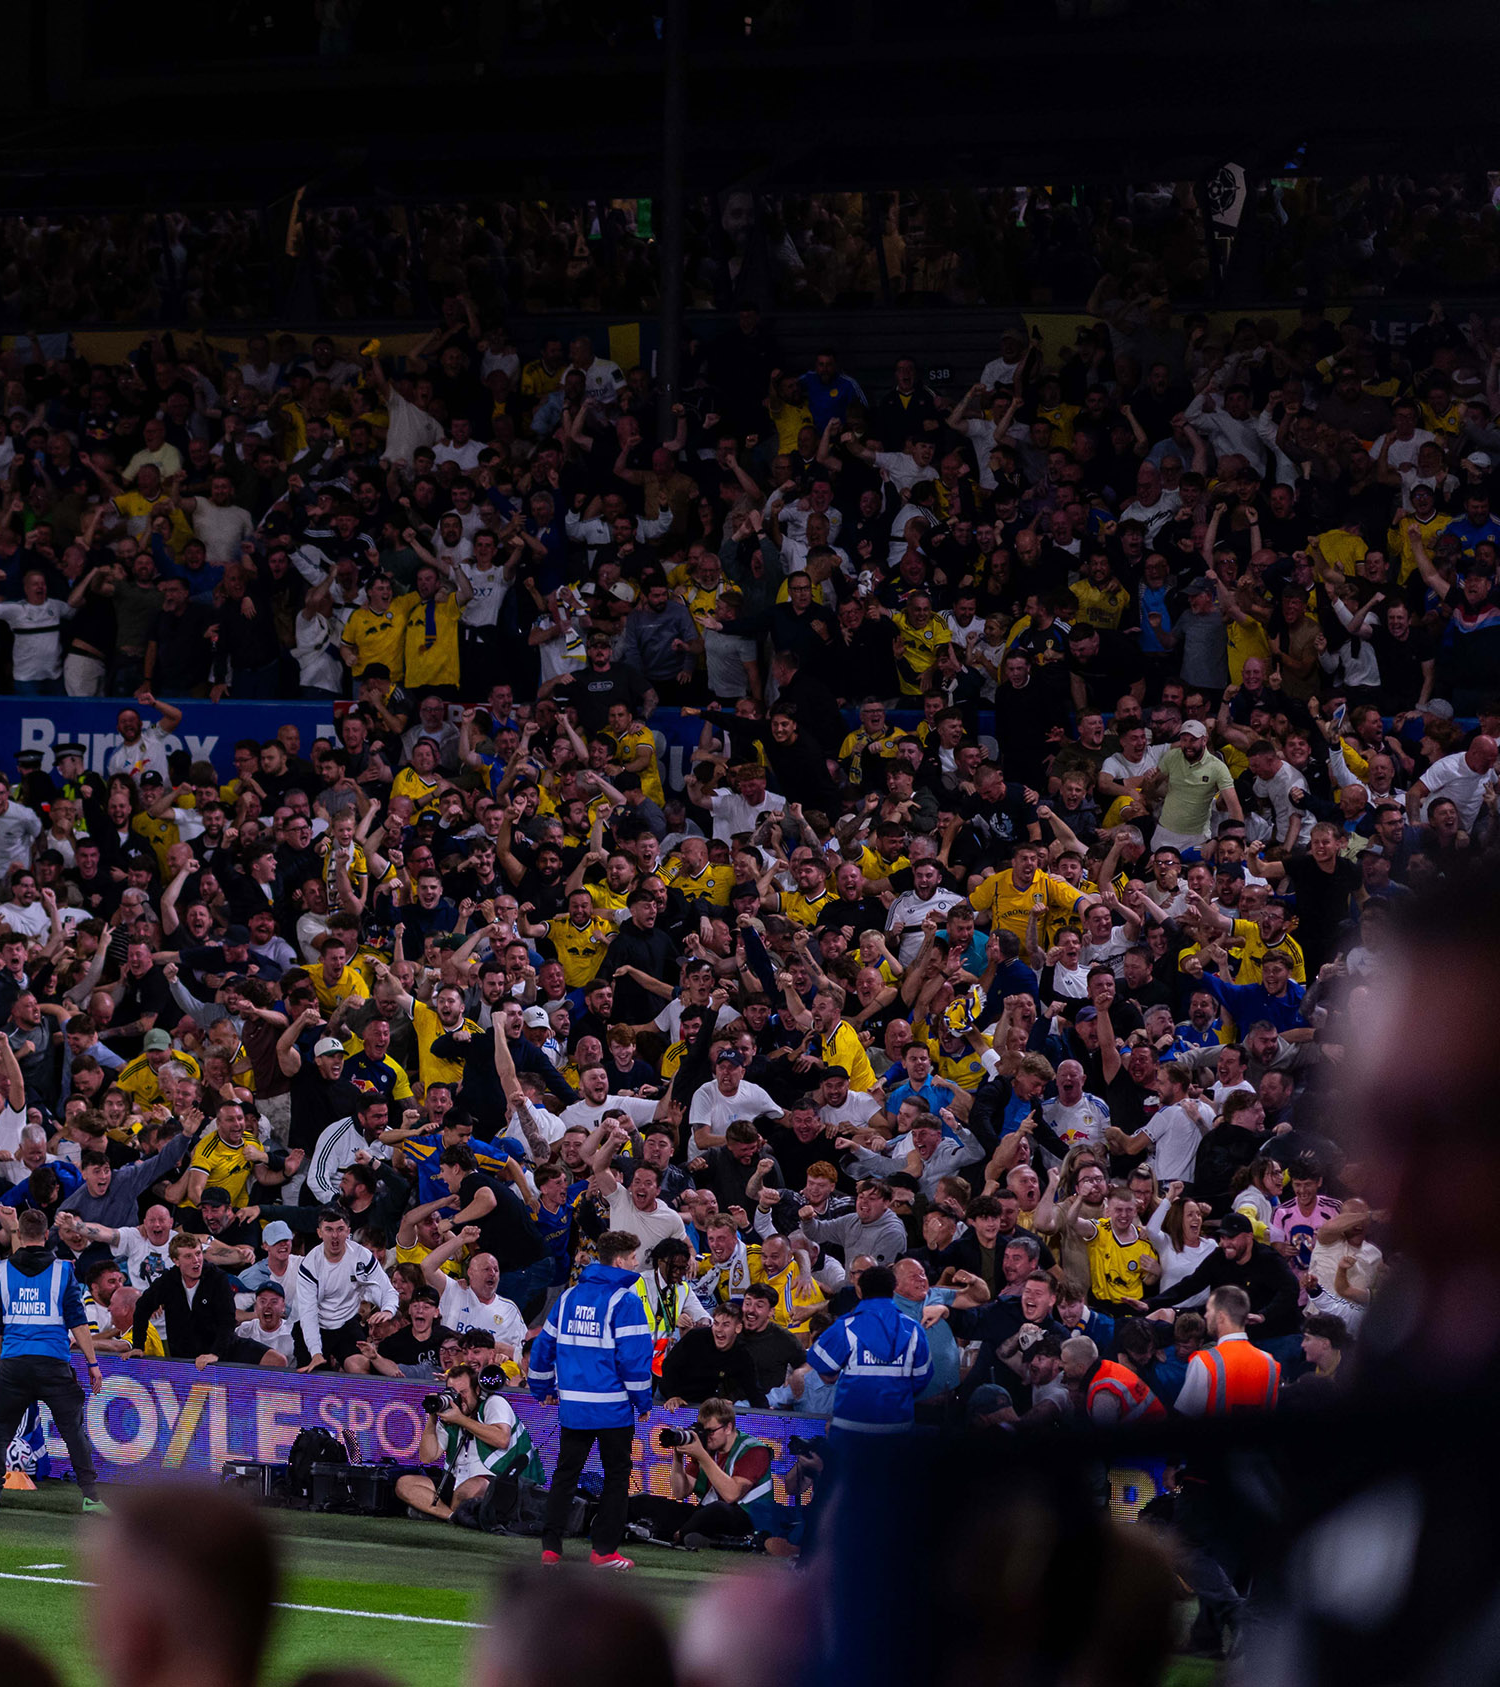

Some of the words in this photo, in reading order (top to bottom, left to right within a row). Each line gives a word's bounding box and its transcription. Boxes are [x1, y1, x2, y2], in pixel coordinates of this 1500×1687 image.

[929, 369, 950, 381] S3B
[21, 718, 219, 782] Burex
[1002, 908, 1031, 919] STRONG
[19, 1287, 39, 1301] PITCH
[12, 1301, 46, 1315] RUNNER
[575, 1305, 596, 1320] PITCH
[567, 1319, 601, 1336] RUNNER
[319, 1395, 426, 1458] SPO
